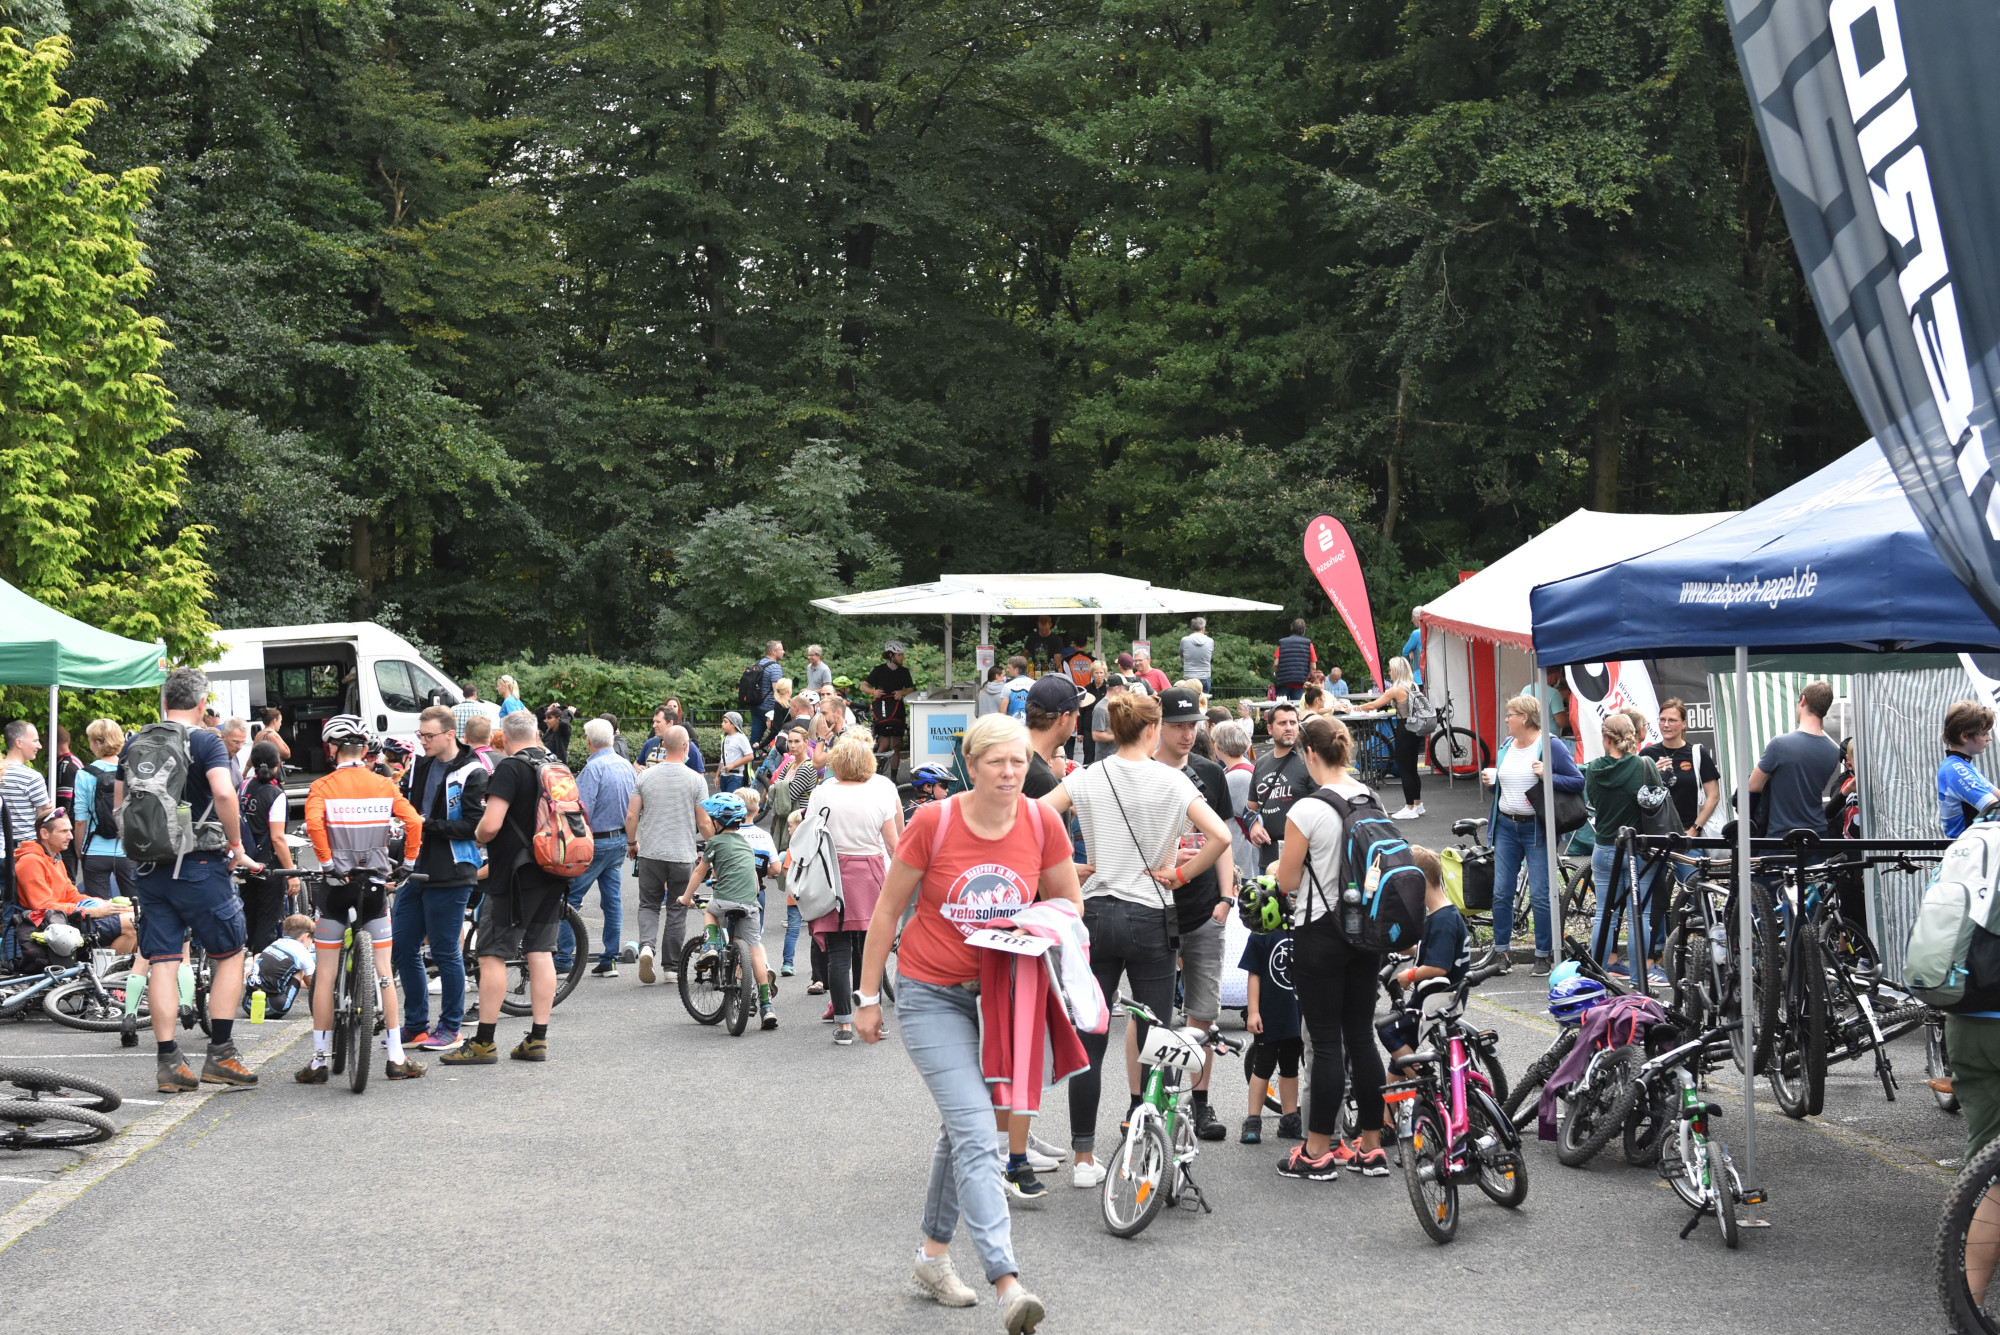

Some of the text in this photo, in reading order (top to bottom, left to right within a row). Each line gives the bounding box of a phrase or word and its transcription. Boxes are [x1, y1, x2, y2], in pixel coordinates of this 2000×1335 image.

[1679, 564, 1819, 610] www.radsport-nagel.de
[930, 727, 964, 735] HAANER
[333, 805, 389, 814] LOCOCYCLES
[950, 907, 1022, 920] velosolinge
[1154, 1045, 1191, 1066] 471
